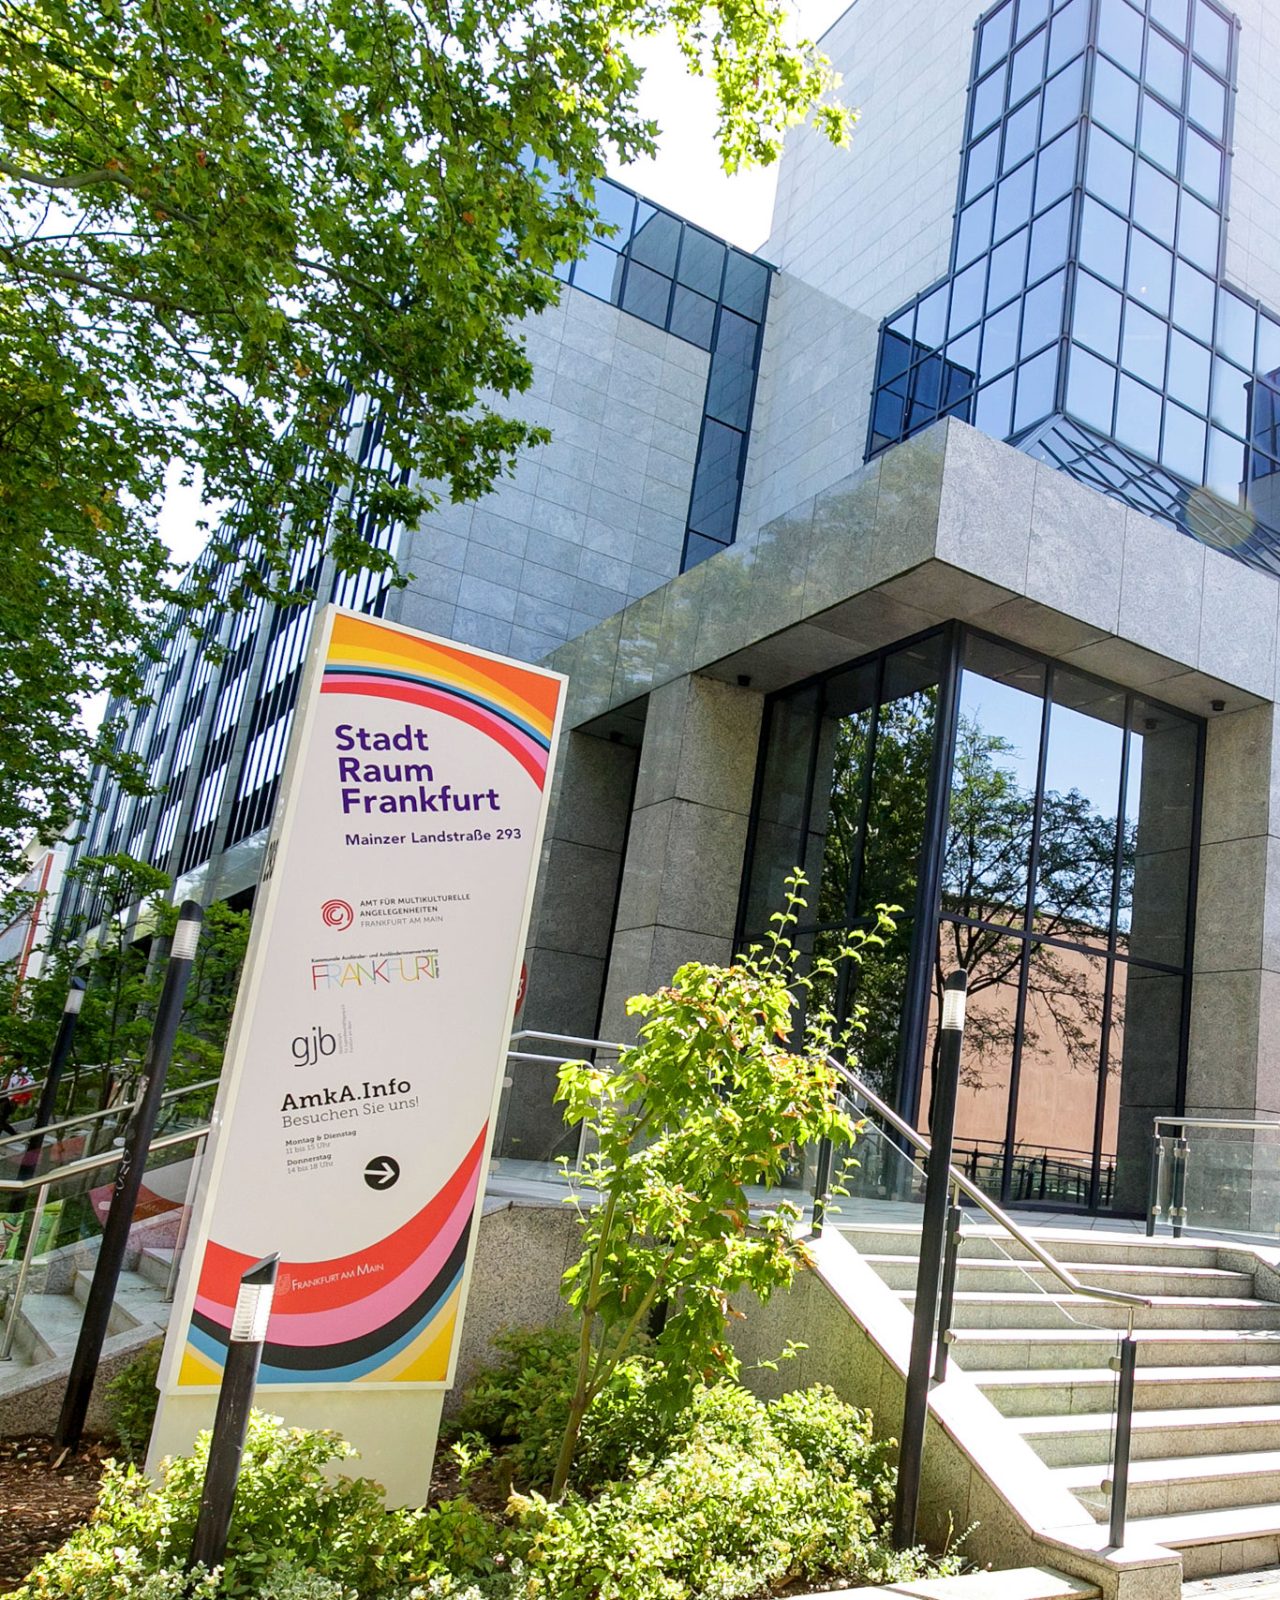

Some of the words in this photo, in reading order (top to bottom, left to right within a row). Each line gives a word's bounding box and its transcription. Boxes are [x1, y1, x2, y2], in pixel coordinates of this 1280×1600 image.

[334, 724, 429, 751] Stadt
[338, 756, 434, 783] Raum
[341, 785, 501, 814] Frankfurt
[345, 833, 406, 846] Mainzer
[411, 829, 491, 844] Landstraße
[495, 828, 521, 841] 293
[360, 899, 377, 907] AMT
[380, 897, 396, 906] FÜR
[397, 893, 471, 905] MULTIKULTURELLE
[360, 906, 438, 917] ANGELEGENHEITEN
[360, 917, 408, 928] FRANKFURT
[423, 915, 444, 923] MAIN
[312, 955, 438, 991] FRANKFURT
[291, 1026, 337, 1067] gjb
[280, 1078, 411, 1112] AmkA.Info
[282, 1107, 359, 1128] Besuchen
[362, 1103, 385, 1116] Sie
[388, 1096, 419, 1111] uns!
[285, 1137, 315, 1147] Montag
[323, 1130, 357, 1140] Dienstag
[317, 1141, 331, 1149] Uhr
[287, 1153, 332, 1166] Donnerstag
[320, 1160, 334, 1168] Uhr
